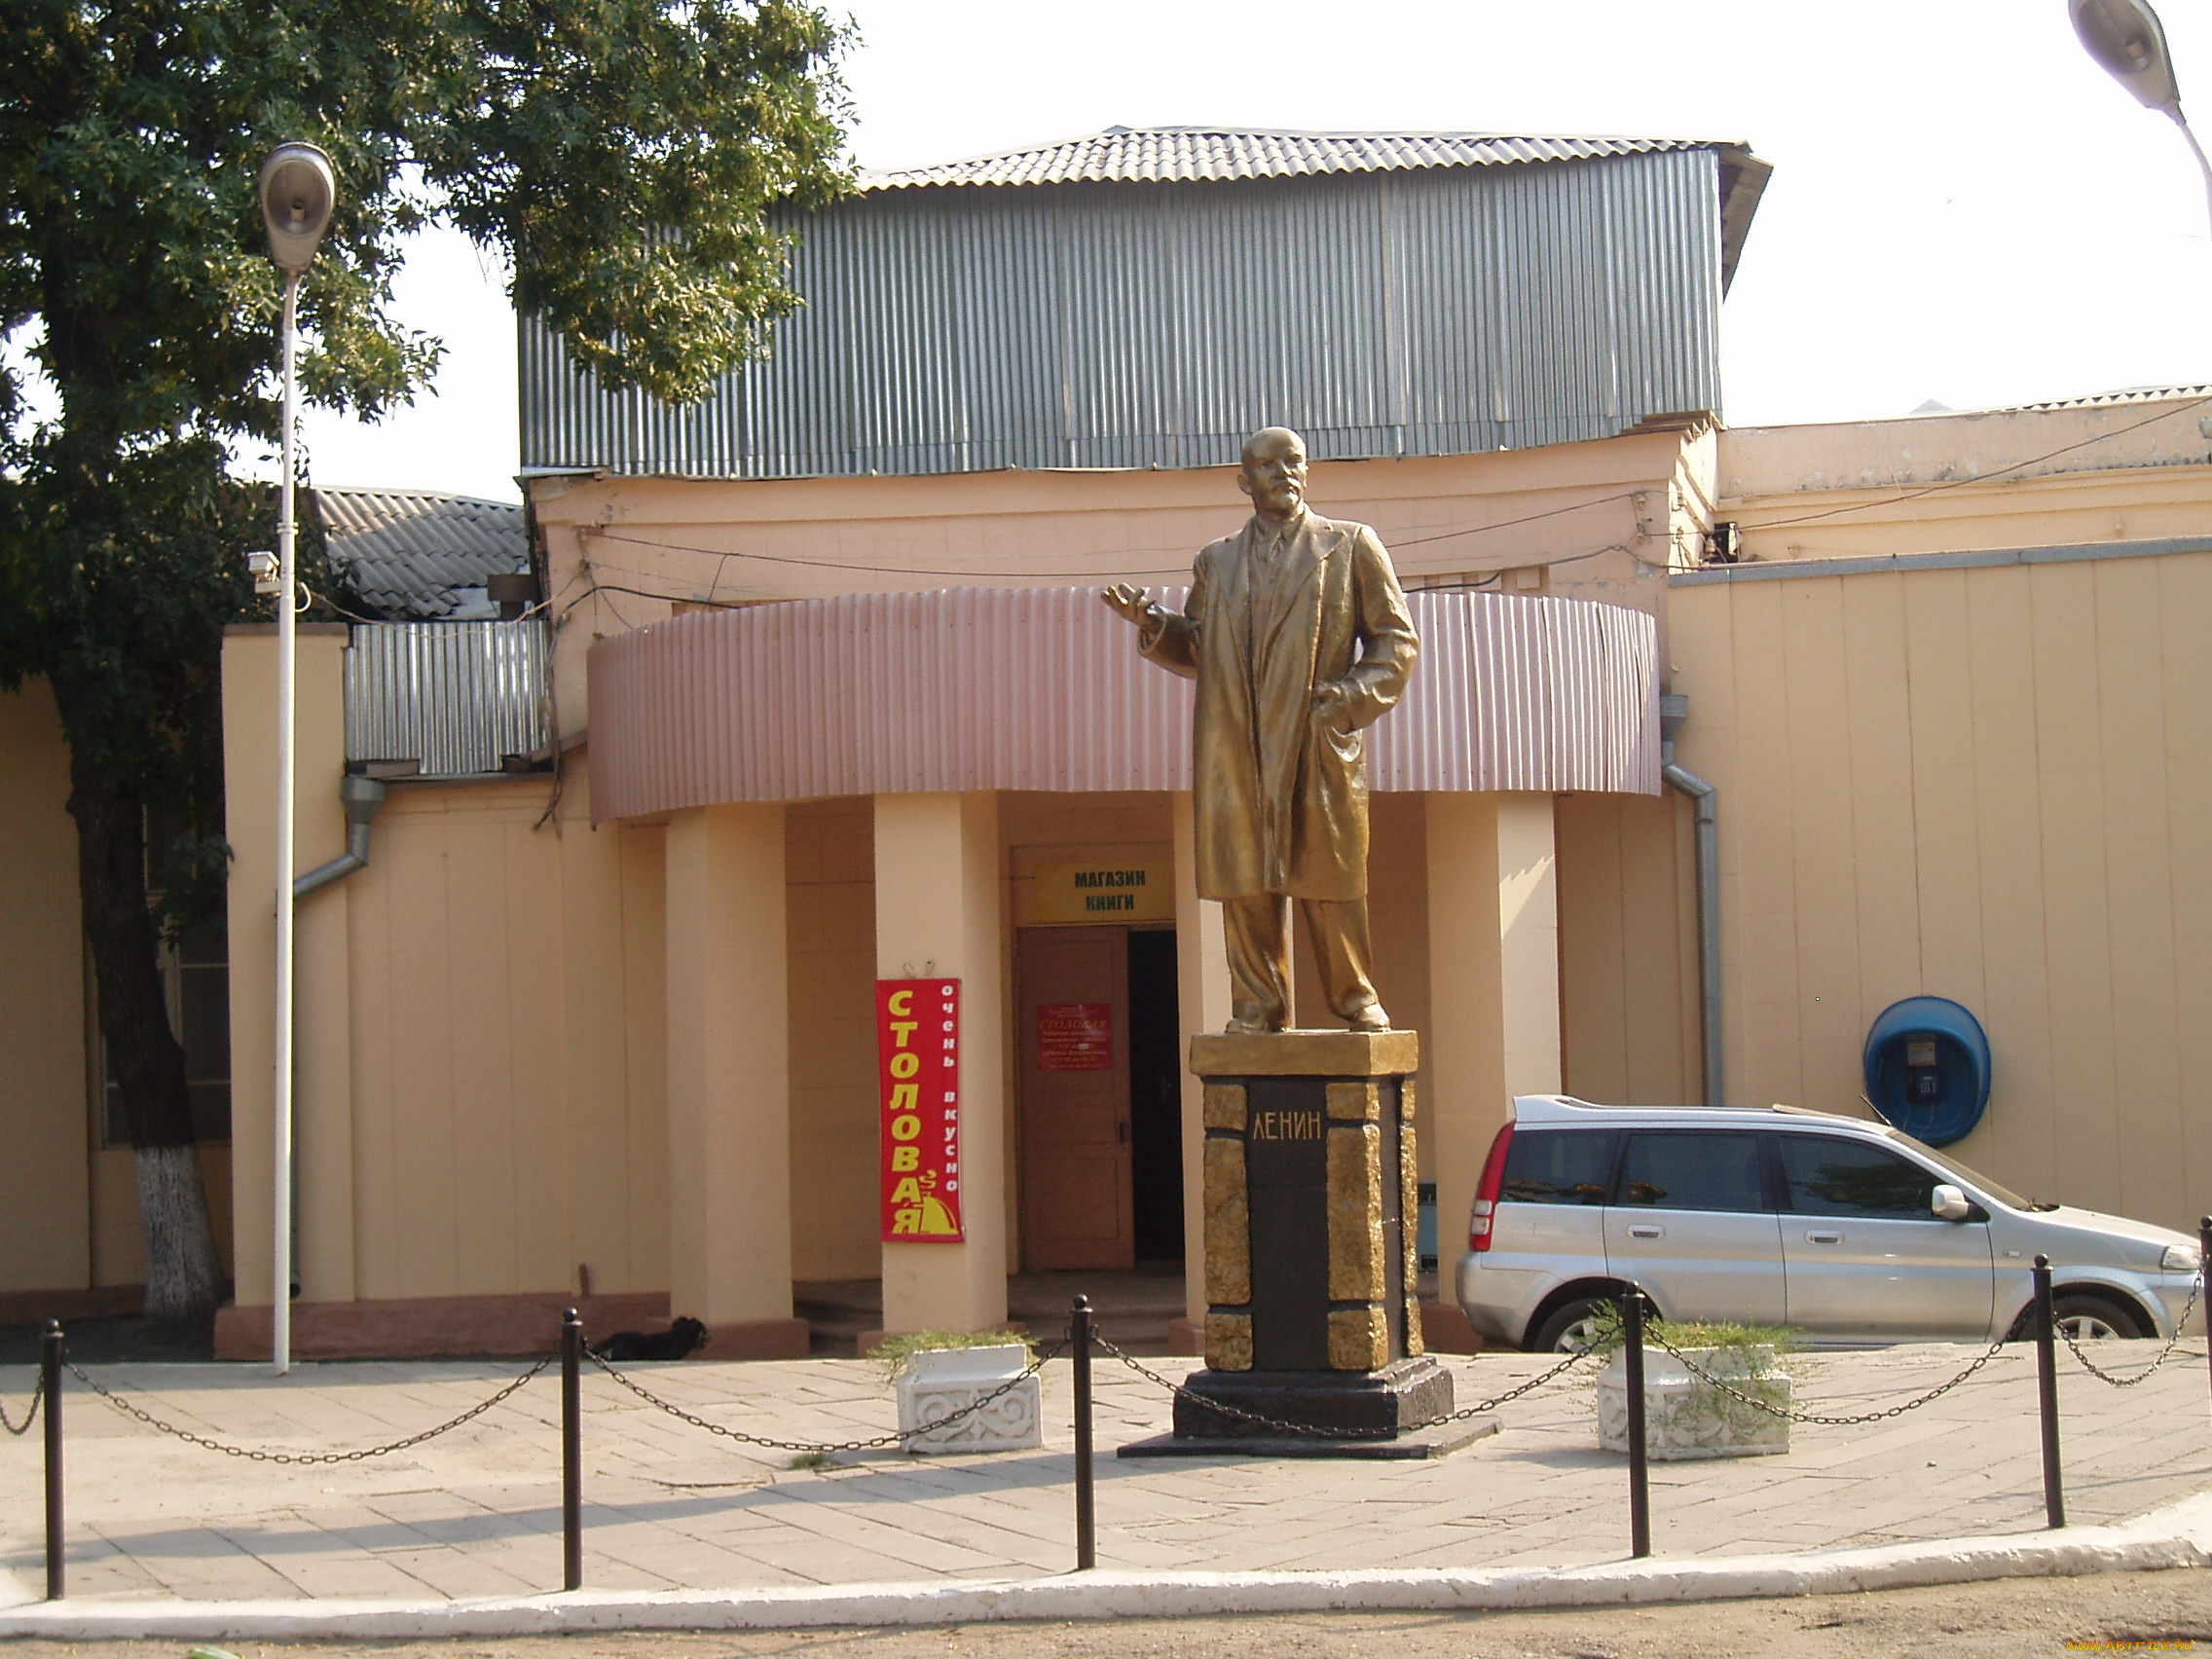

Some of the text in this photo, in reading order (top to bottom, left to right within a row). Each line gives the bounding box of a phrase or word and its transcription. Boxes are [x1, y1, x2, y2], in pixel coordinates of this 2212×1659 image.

[1075, 870, 1146, 888] МАГАЗИН
[1086, 894, 1134, 911] КНИГИ
[888, 990, 923, 1235] СТОЛОВАЯ
[1253, 1111, 1321, 1140] ЛЕНИН
